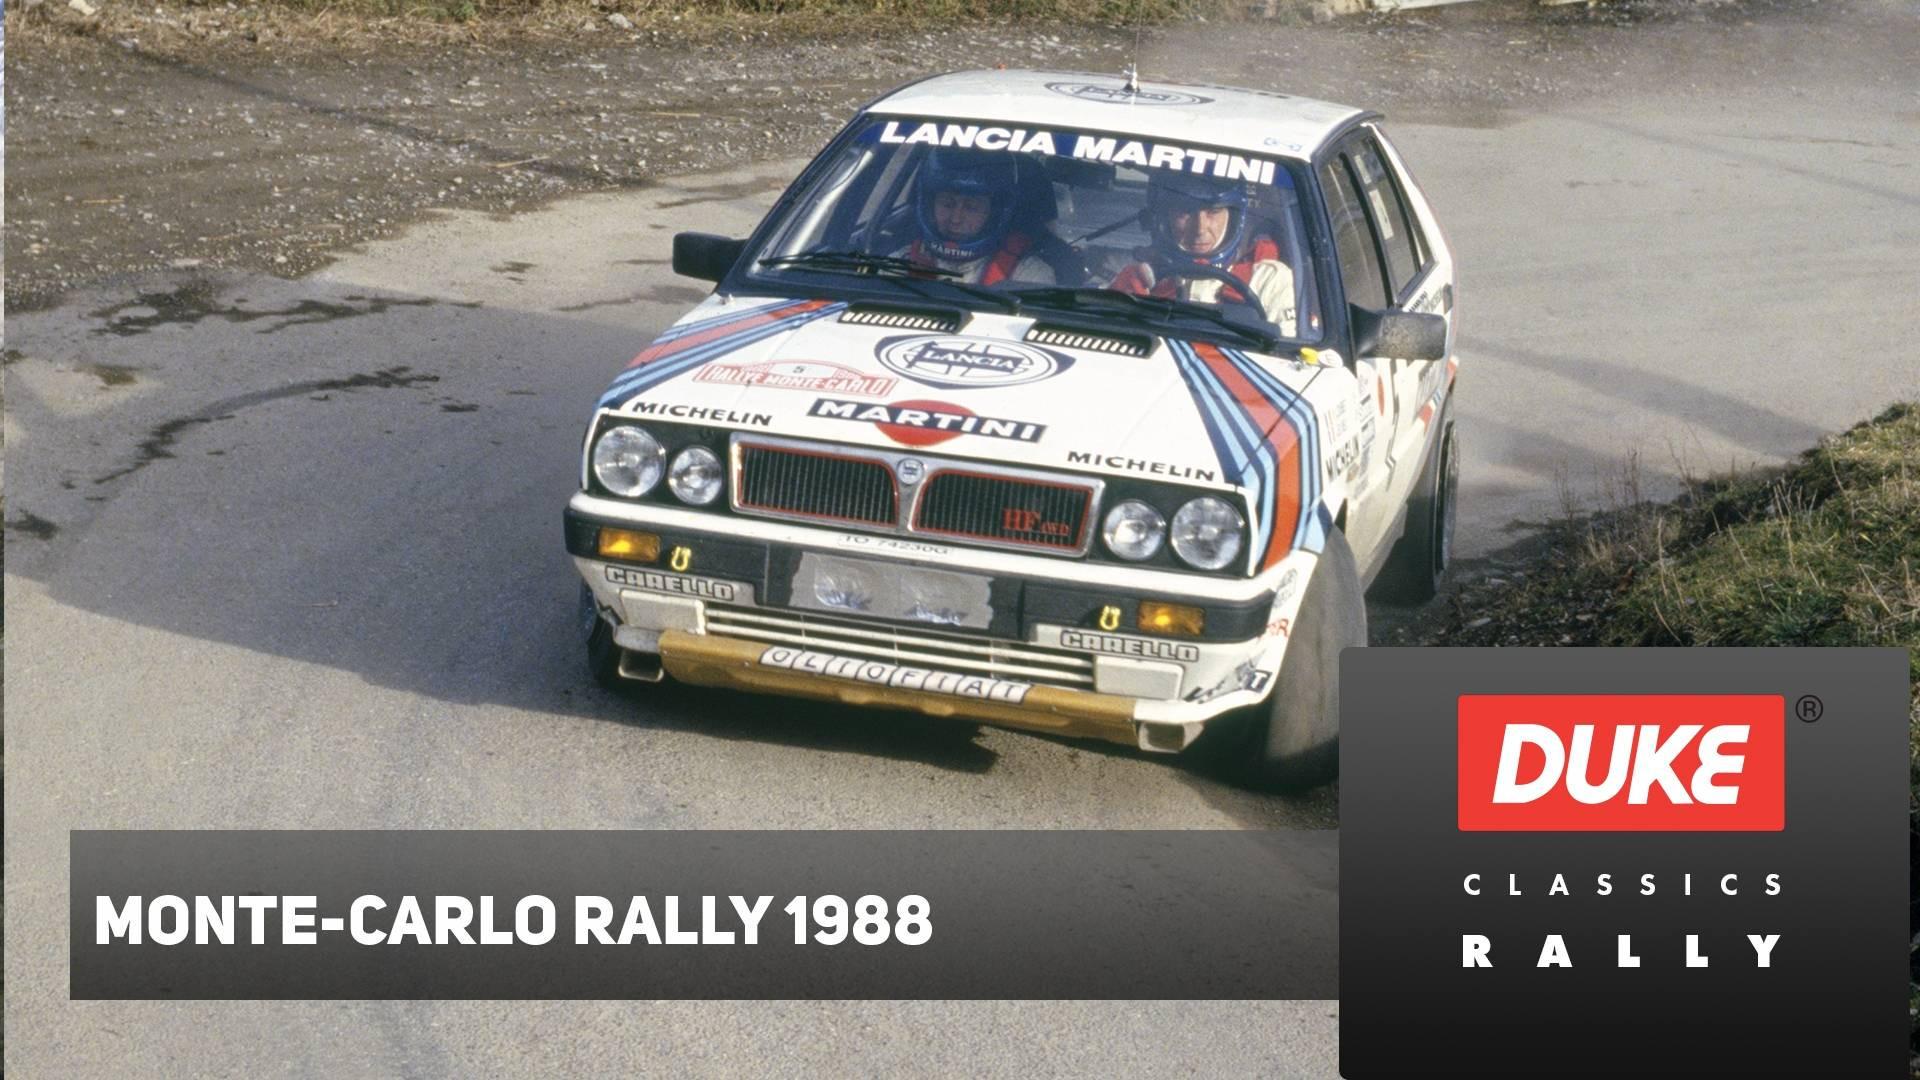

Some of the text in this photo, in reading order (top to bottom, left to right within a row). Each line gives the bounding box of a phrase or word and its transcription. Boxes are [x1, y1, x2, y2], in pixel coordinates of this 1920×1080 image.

[880, 121, 1276, 185] LANCIA MARTINI
[926, 349, 1014, 369] LANCIA
[707, 364, 764, 384] RALLYE
[763, 372, 890, 394] MONTE-CARLO
[631, 401, 773, 426] MICHELIN
[816, 400, 1037, 441] MARTINI
[1067, 450, 1216, 482] MICHELIN
[1003, 508, 1041, 532] HF
[604, 565, 735, 601] CARELLO
[1060, 629, 1199, 662] CARELLO
